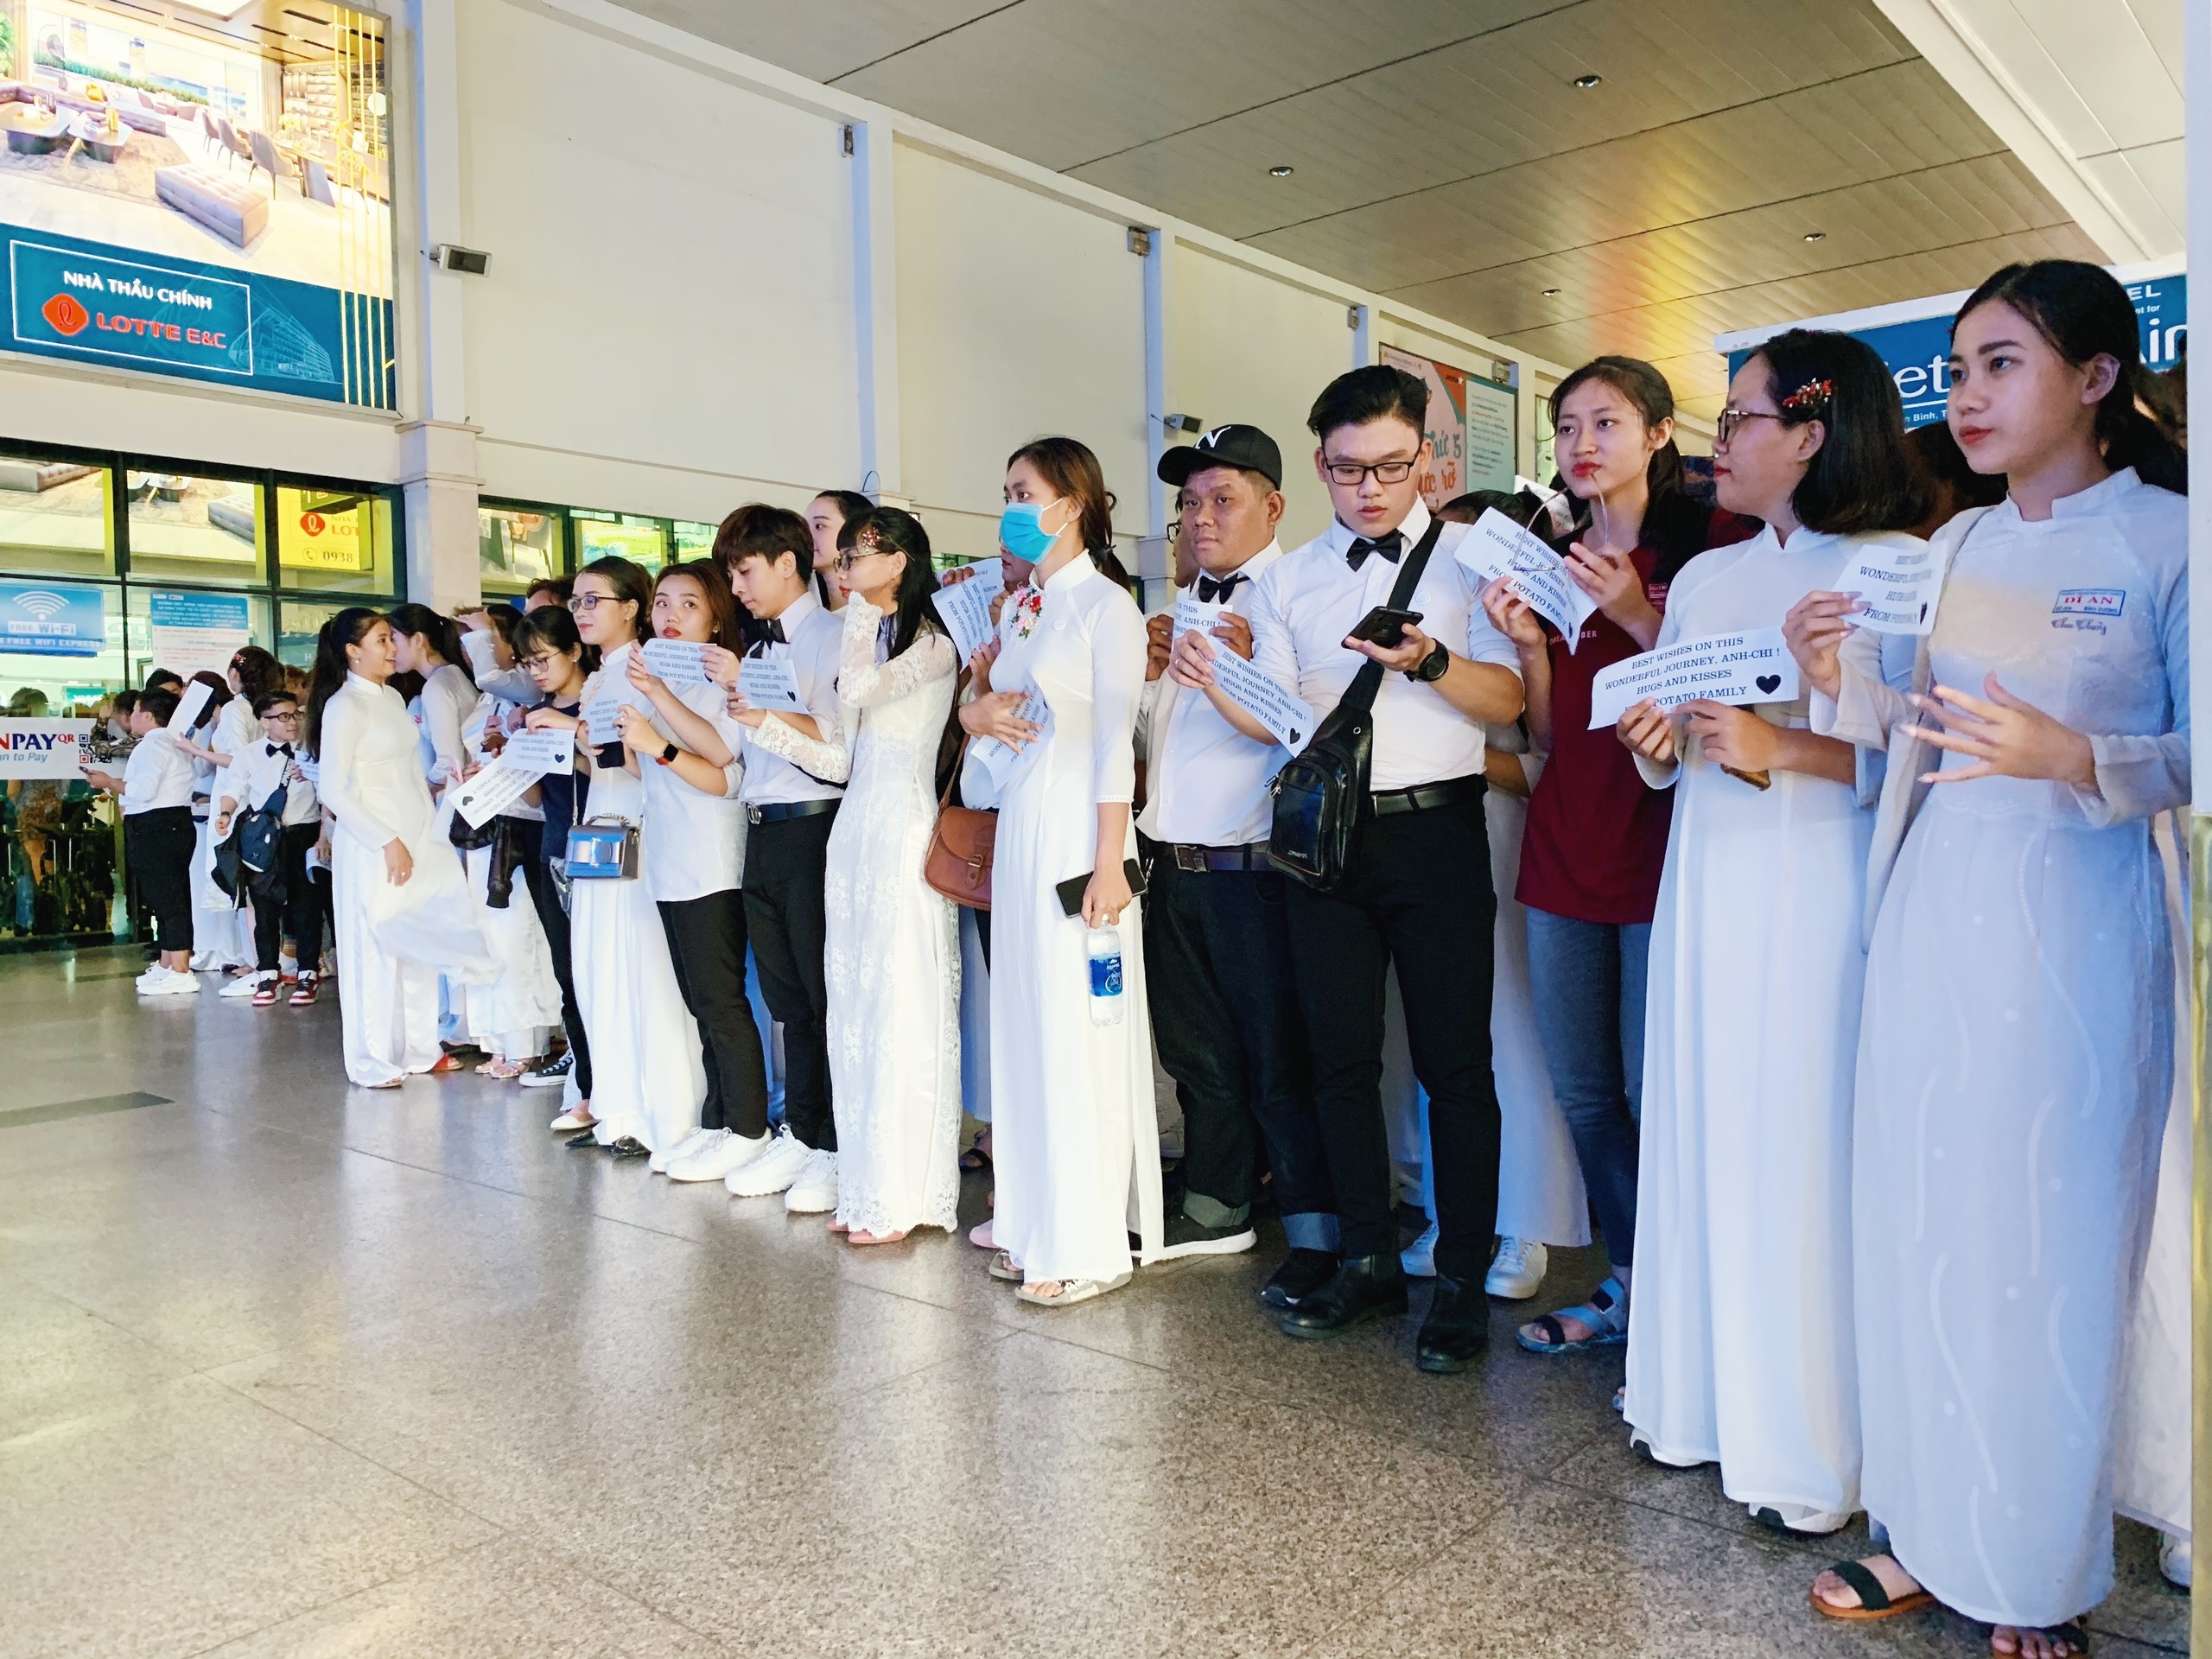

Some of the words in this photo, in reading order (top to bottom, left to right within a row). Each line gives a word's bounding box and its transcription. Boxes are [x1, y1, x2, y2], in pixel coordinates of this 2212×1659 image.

[63, 270, 104, 291] NHÀ
[107, 277, 153, 300] THẦU
[158, 288, 213, 309] CHÍNH
[97, 312, 181, 341] LOTTE
[188, 329, 226, 349] E&C
[1885, 355, 1950, 397] et
[323, 551, 353, 563] 0938
[1486, 528, 1535, 565] WONDEFUL
[1489, 565, 1508, 577] FRO
[1513, 581, 1546, 606] POTATO
[1546, 603, 1567, 626] FAMILY
[1531, 575, 1548, 589] AND
[1183, 604, 1198, 613] THIS
[38, 623, 74, 634] Wi-Fi
[1222, 652, 1236, 664] BEST
[1237, 661, 1262, 680] WISHES
[1264, 677, 1273, 687] ON
[1605, 668, 1662, 690] WONDERFUL
[1722, 648, 1773, 663] ANH-CHI
[1632, 656, 1654, 670] BEST
[1656, 645, 1692, 662] WISHES
[1695, 641, 1712, 651] ON
[1715, 637, 1744, 648] THIS
[1224, 677, 1242, 691] HUGS
[1244, 689, 1259, 700] AND
[1261, 697, 1282, 716] KISSES
[1637, 681, 1662, 695] HUGS
[1665, 675, 1687, 688] AND
[1691, 669, 1732, 682] KISSES
[1654, 692, 1696, 706] POTATO
[1700, 686, 1747, 699] FAMILY
[1237, 695, 1264, 716] POTATO
[1264, 713, 1286, 734] FAMILY
[58, 734, 75, 744] QR
[14, 753, 25, 761] to
[28, 752, 48, 763] Pay
